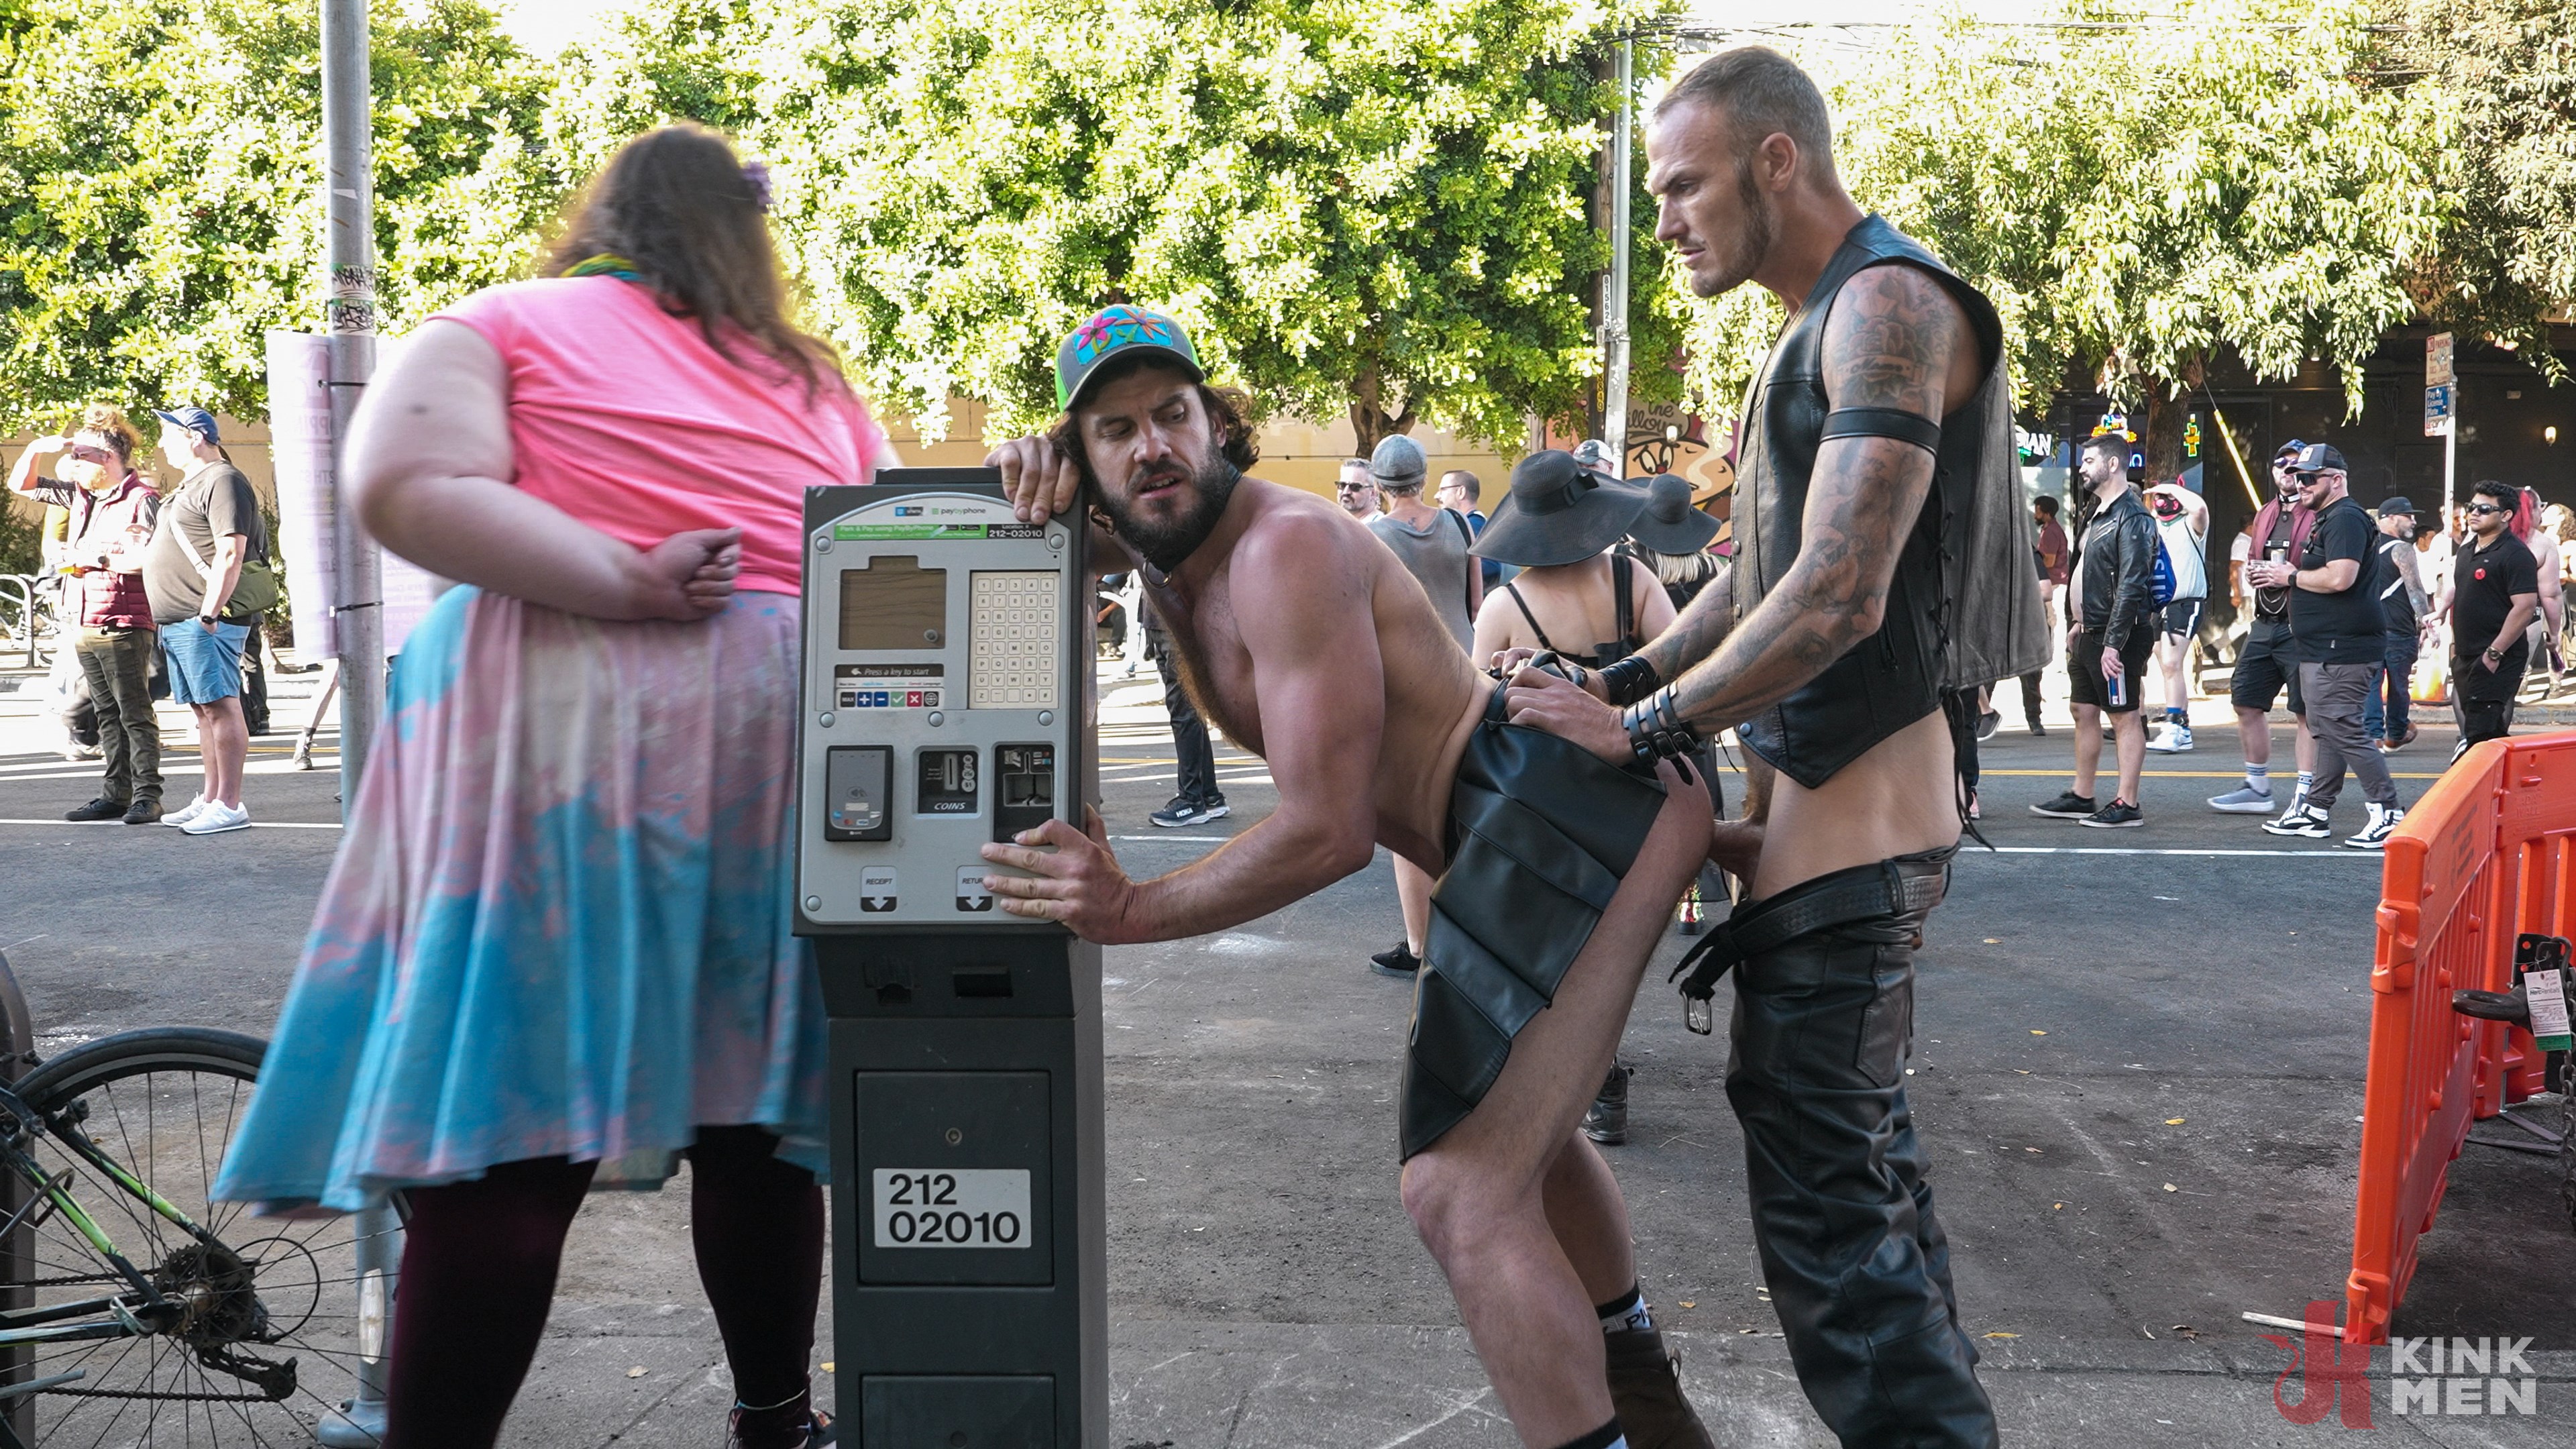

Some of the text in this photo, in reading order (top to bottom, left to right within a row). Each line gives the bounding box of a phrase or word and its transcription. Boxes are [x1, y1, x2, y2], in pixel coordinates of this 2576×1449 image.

[890, 667, 902, 676] key
[1176, 808, 1193, 818] HOKA
[890, 1174, 957, 1205] 212
[889, 1211, 1020, 1243] 02010
